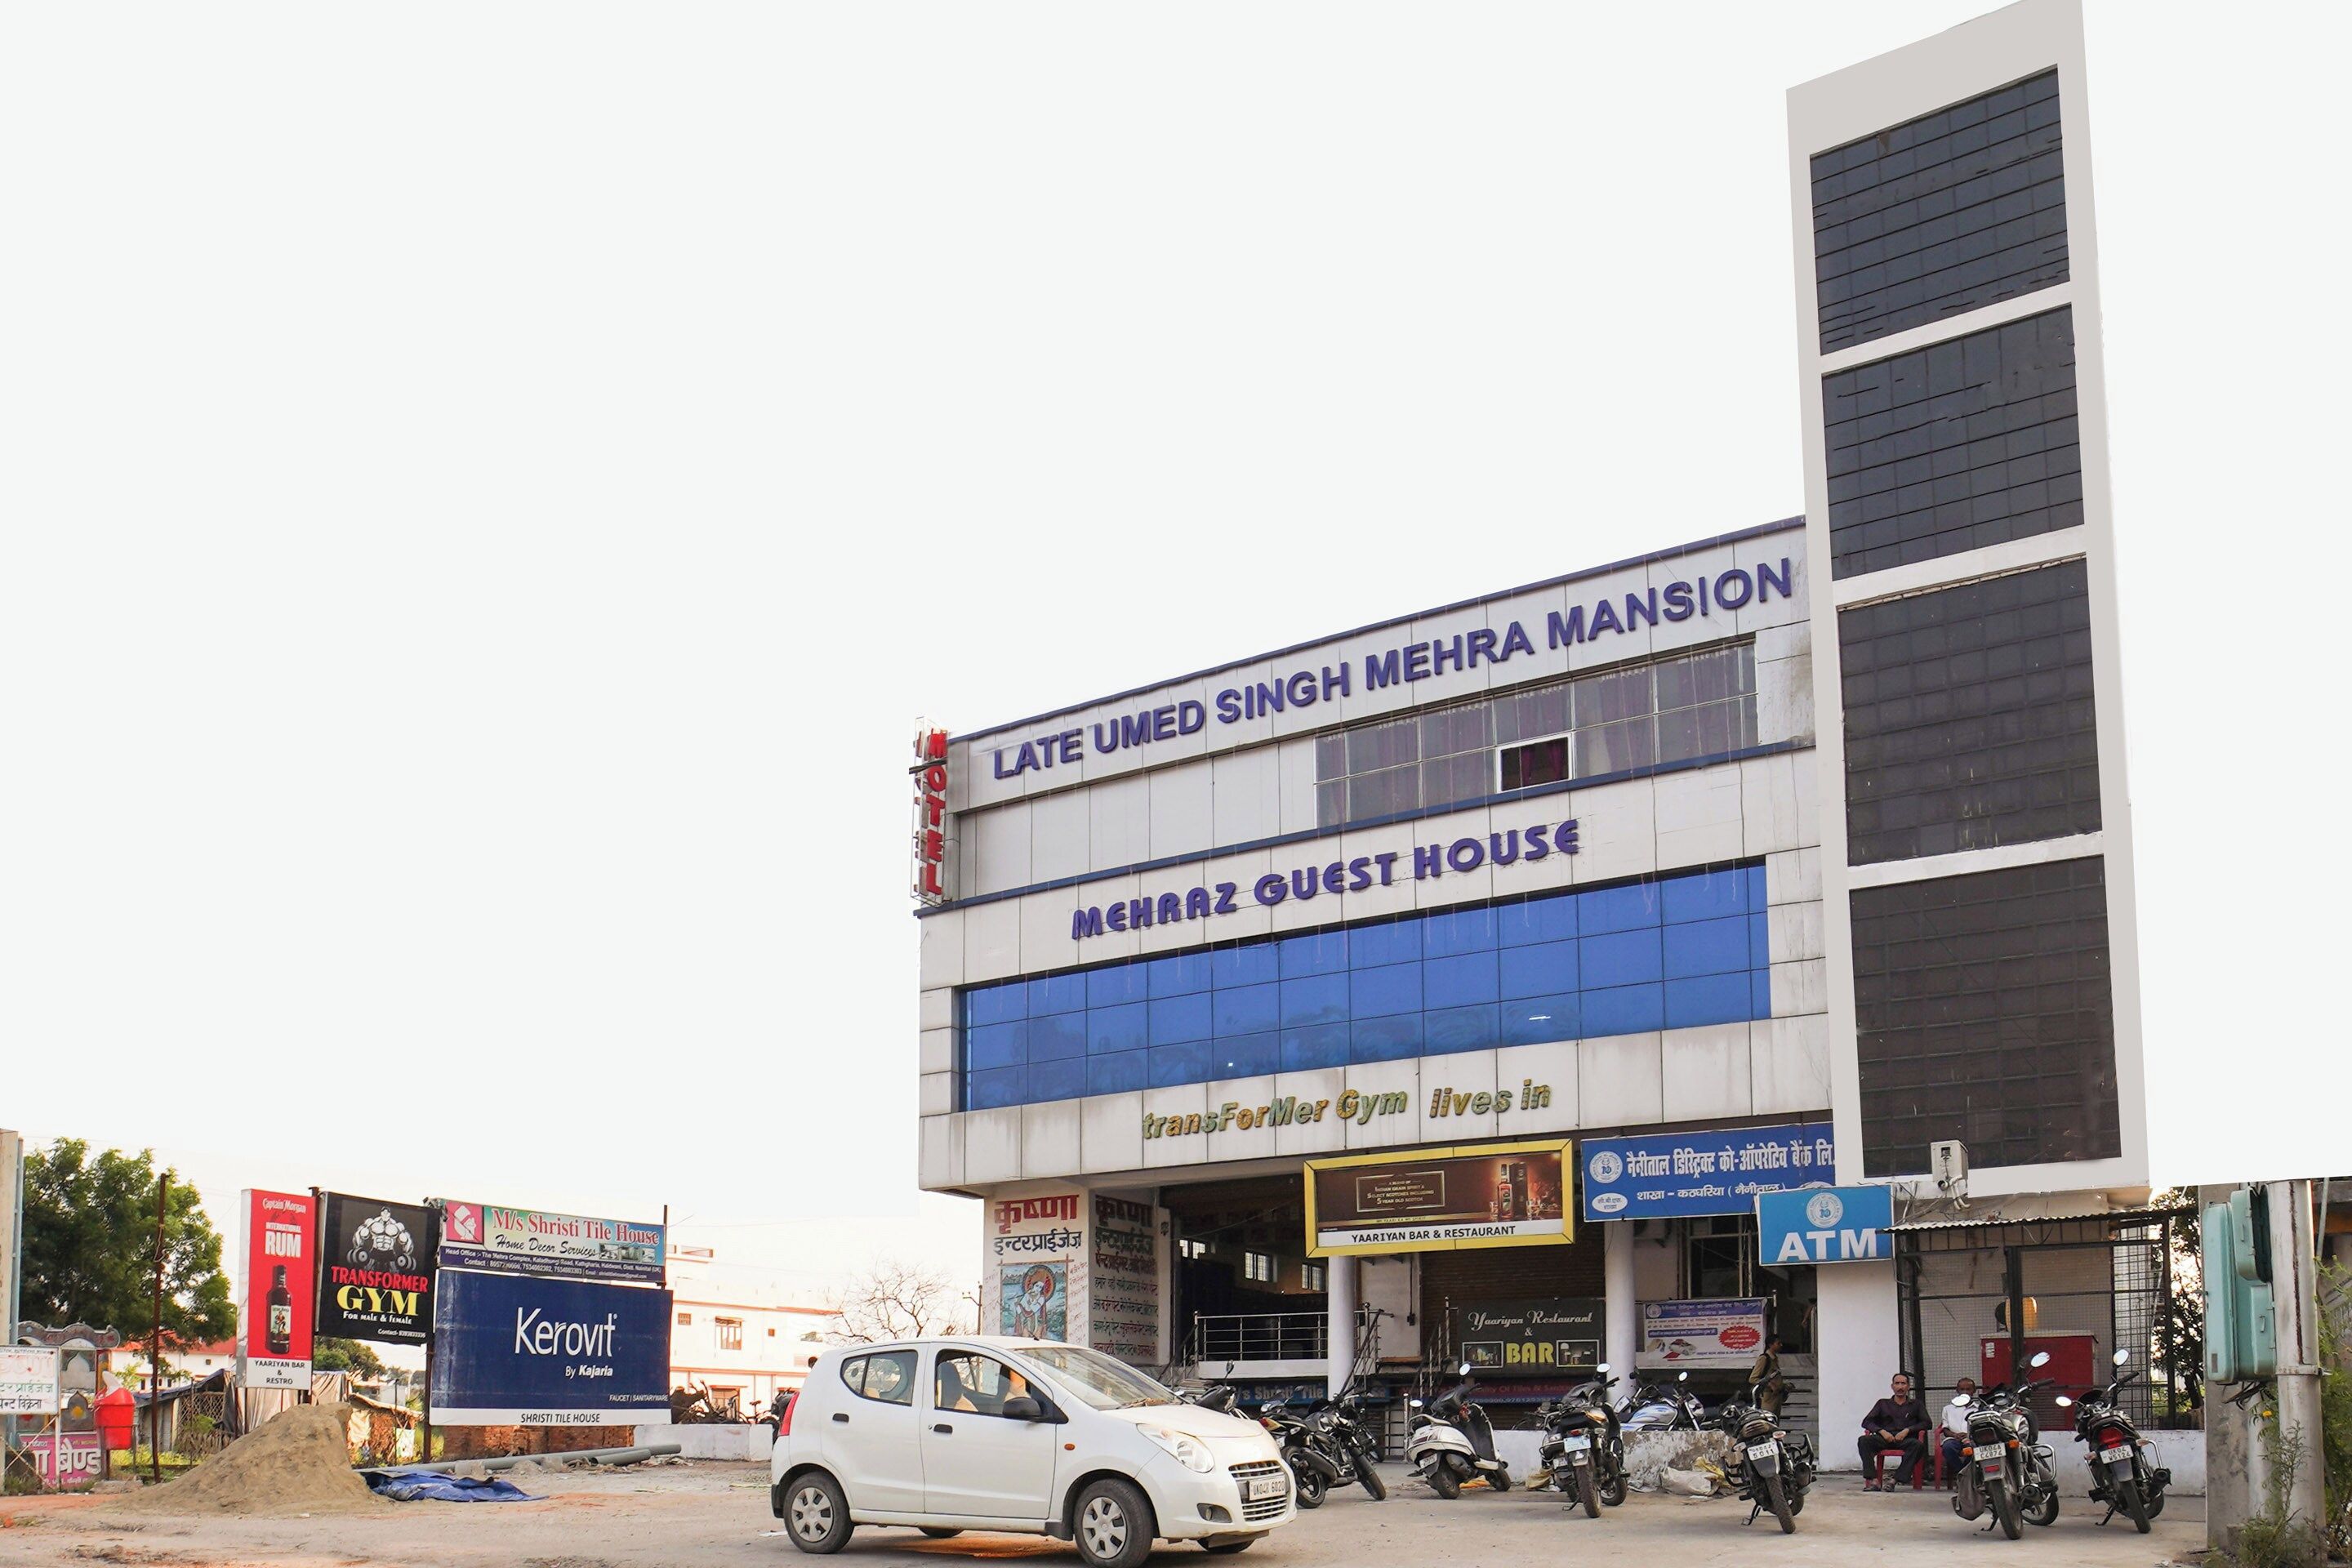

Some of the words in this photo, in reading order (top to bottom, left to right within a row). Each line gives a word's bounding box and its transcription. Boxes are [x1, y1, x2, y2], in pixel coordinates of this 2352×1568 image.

[994, 728, 1083, 780] LATE
[1094, 699, 1205, 754] UMED
[1217, 663, 1350, 724] SINGH
[1365, 621, 1535, 690] MEHRA
[1548, 558, 1792, 649] MANSION
[1072, 883, 1238, 940] MEHRAZ
[1254, 853, 1397, 906] GUEST
[1414, 820, 1579, 880] HOUSE
[1336, 1089, 1409, 1125] Gym
[1429, 1088, 1512, 1117] lives
[1521, 1079, 1551, 1110] in
[1626, 1151, 1670, 1177] नैनीताल
[1790, 1139, 1812, 1167] बैंक
[1637, 1191, 1665, 1200] शाखा
[492, 1209, 523, 1232] M/s
[528, 1213, 579, 1237] Shristi
[584, 1220, 612, 1241] Tile
[617, 1224, 659, 1245] House
[994, 1195, 1080, 1234] कृष्णा
[265, 1231, 301, 1258] RUM
[495, 1233, 524, 1250] Home
[528, 1237, 555, 1253] Decor
[559, 1241, 596, 1257] Services
[1352, 1232, 1406, 1243] YAARIYAN
[1410, 1231, 1430, 1240] BAR
[1433, 1229, 1441, 1239] &
[1445, 1226, 1516, 1238] RESTAURANT
[1777, 1228, 1877, 1262] ATM
[331, 1266, 429, 1293] TRANSFORMER
[336, 1285, 421, 1316] GYM
[380, 1314, 387, 1322] &
[1468, 1312, 1524, 1331] Yaariyan
[1526, 1310, 1592, 1324] Restaurant
[1525, 1327, 1533, 1336] &
[255, 1360, 290, 1368] YAARIYAN
[1506, 1342, 1555, 1363] BAR
[565, 1365, 576, 1379] By
[579, 1365, 613, 1378] Kajaria
[521, 1413, 553, 1423] SHRISTI
[555, 1413, 572, 1423] TILE
[573, 1413, 600, 1423] HOUSE
